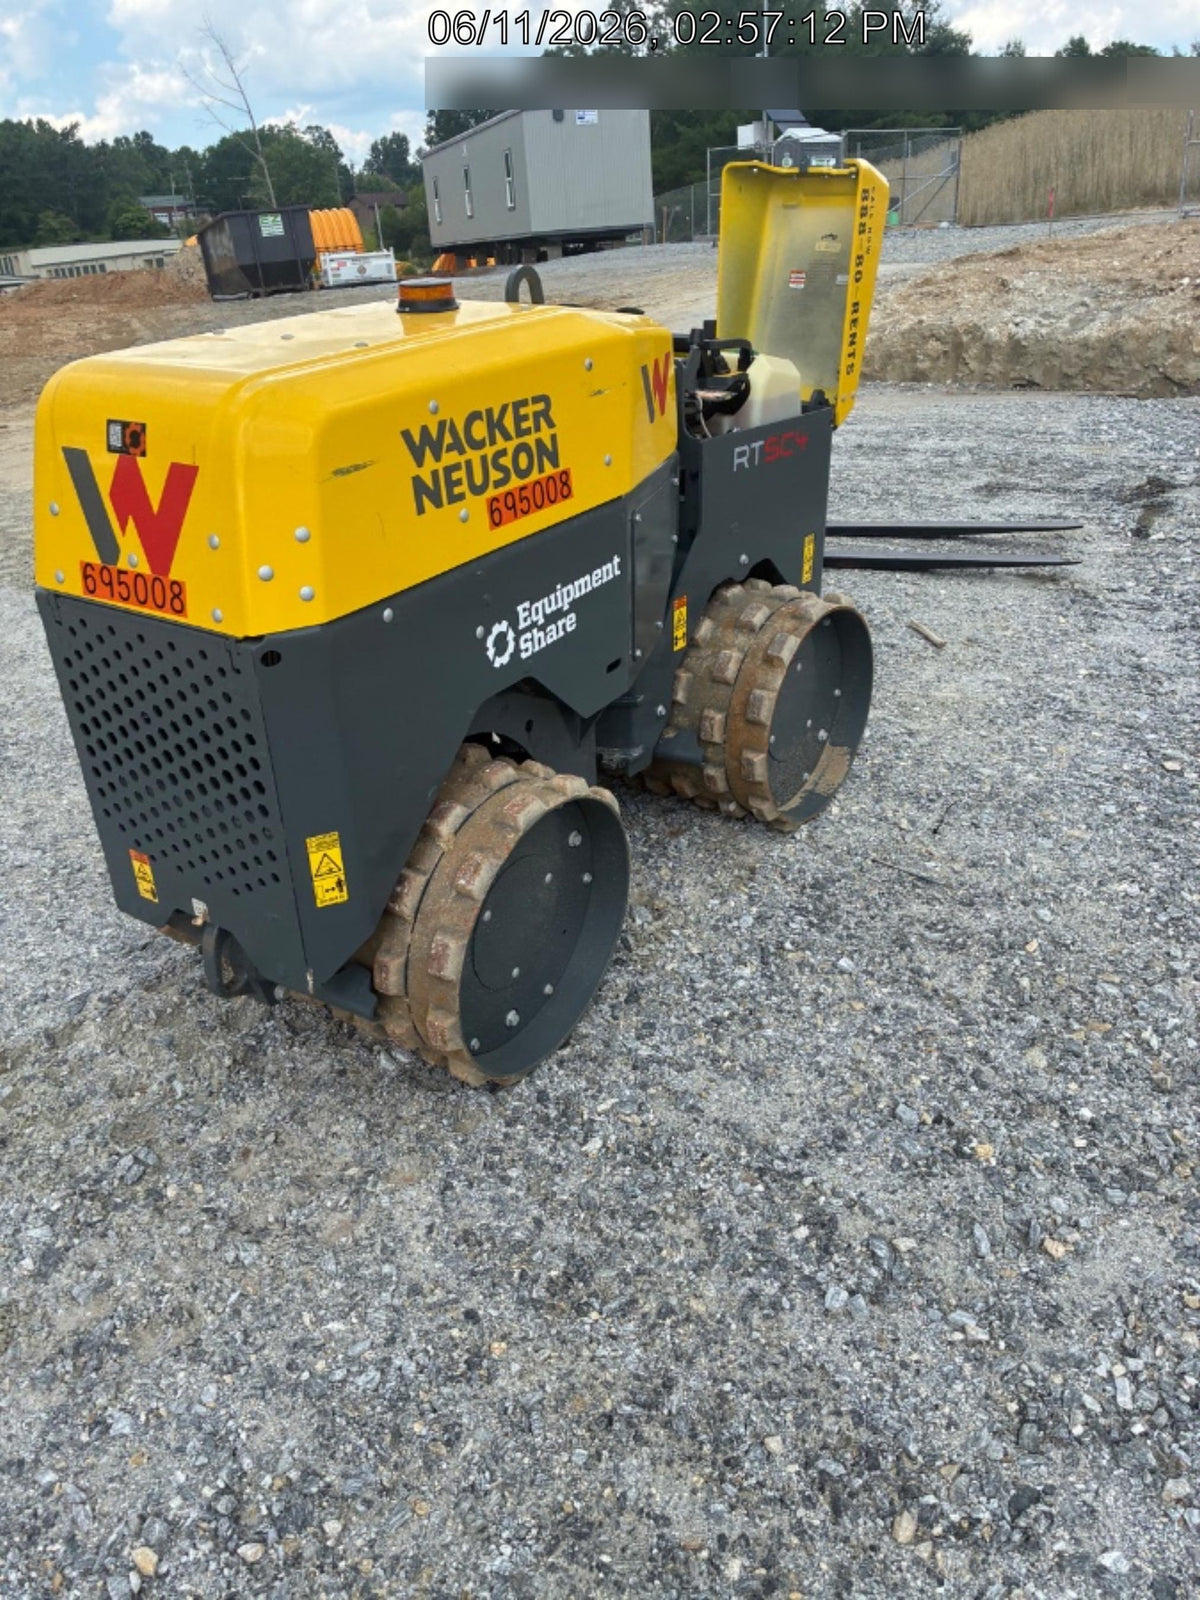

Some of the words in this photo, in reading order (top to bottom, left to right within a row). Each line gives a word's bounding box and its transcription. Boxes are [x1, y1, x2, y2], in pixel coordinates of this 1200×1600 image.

[400, 394, 556, 468] WACKER
[411, 433, 560, 516] NEUSON
[489, 470, 572, 527] 695008
[82, 562, 185, 614] 695008
[517, 554, 621, 630] Equipment
[519, 612, 577, 660] Share
